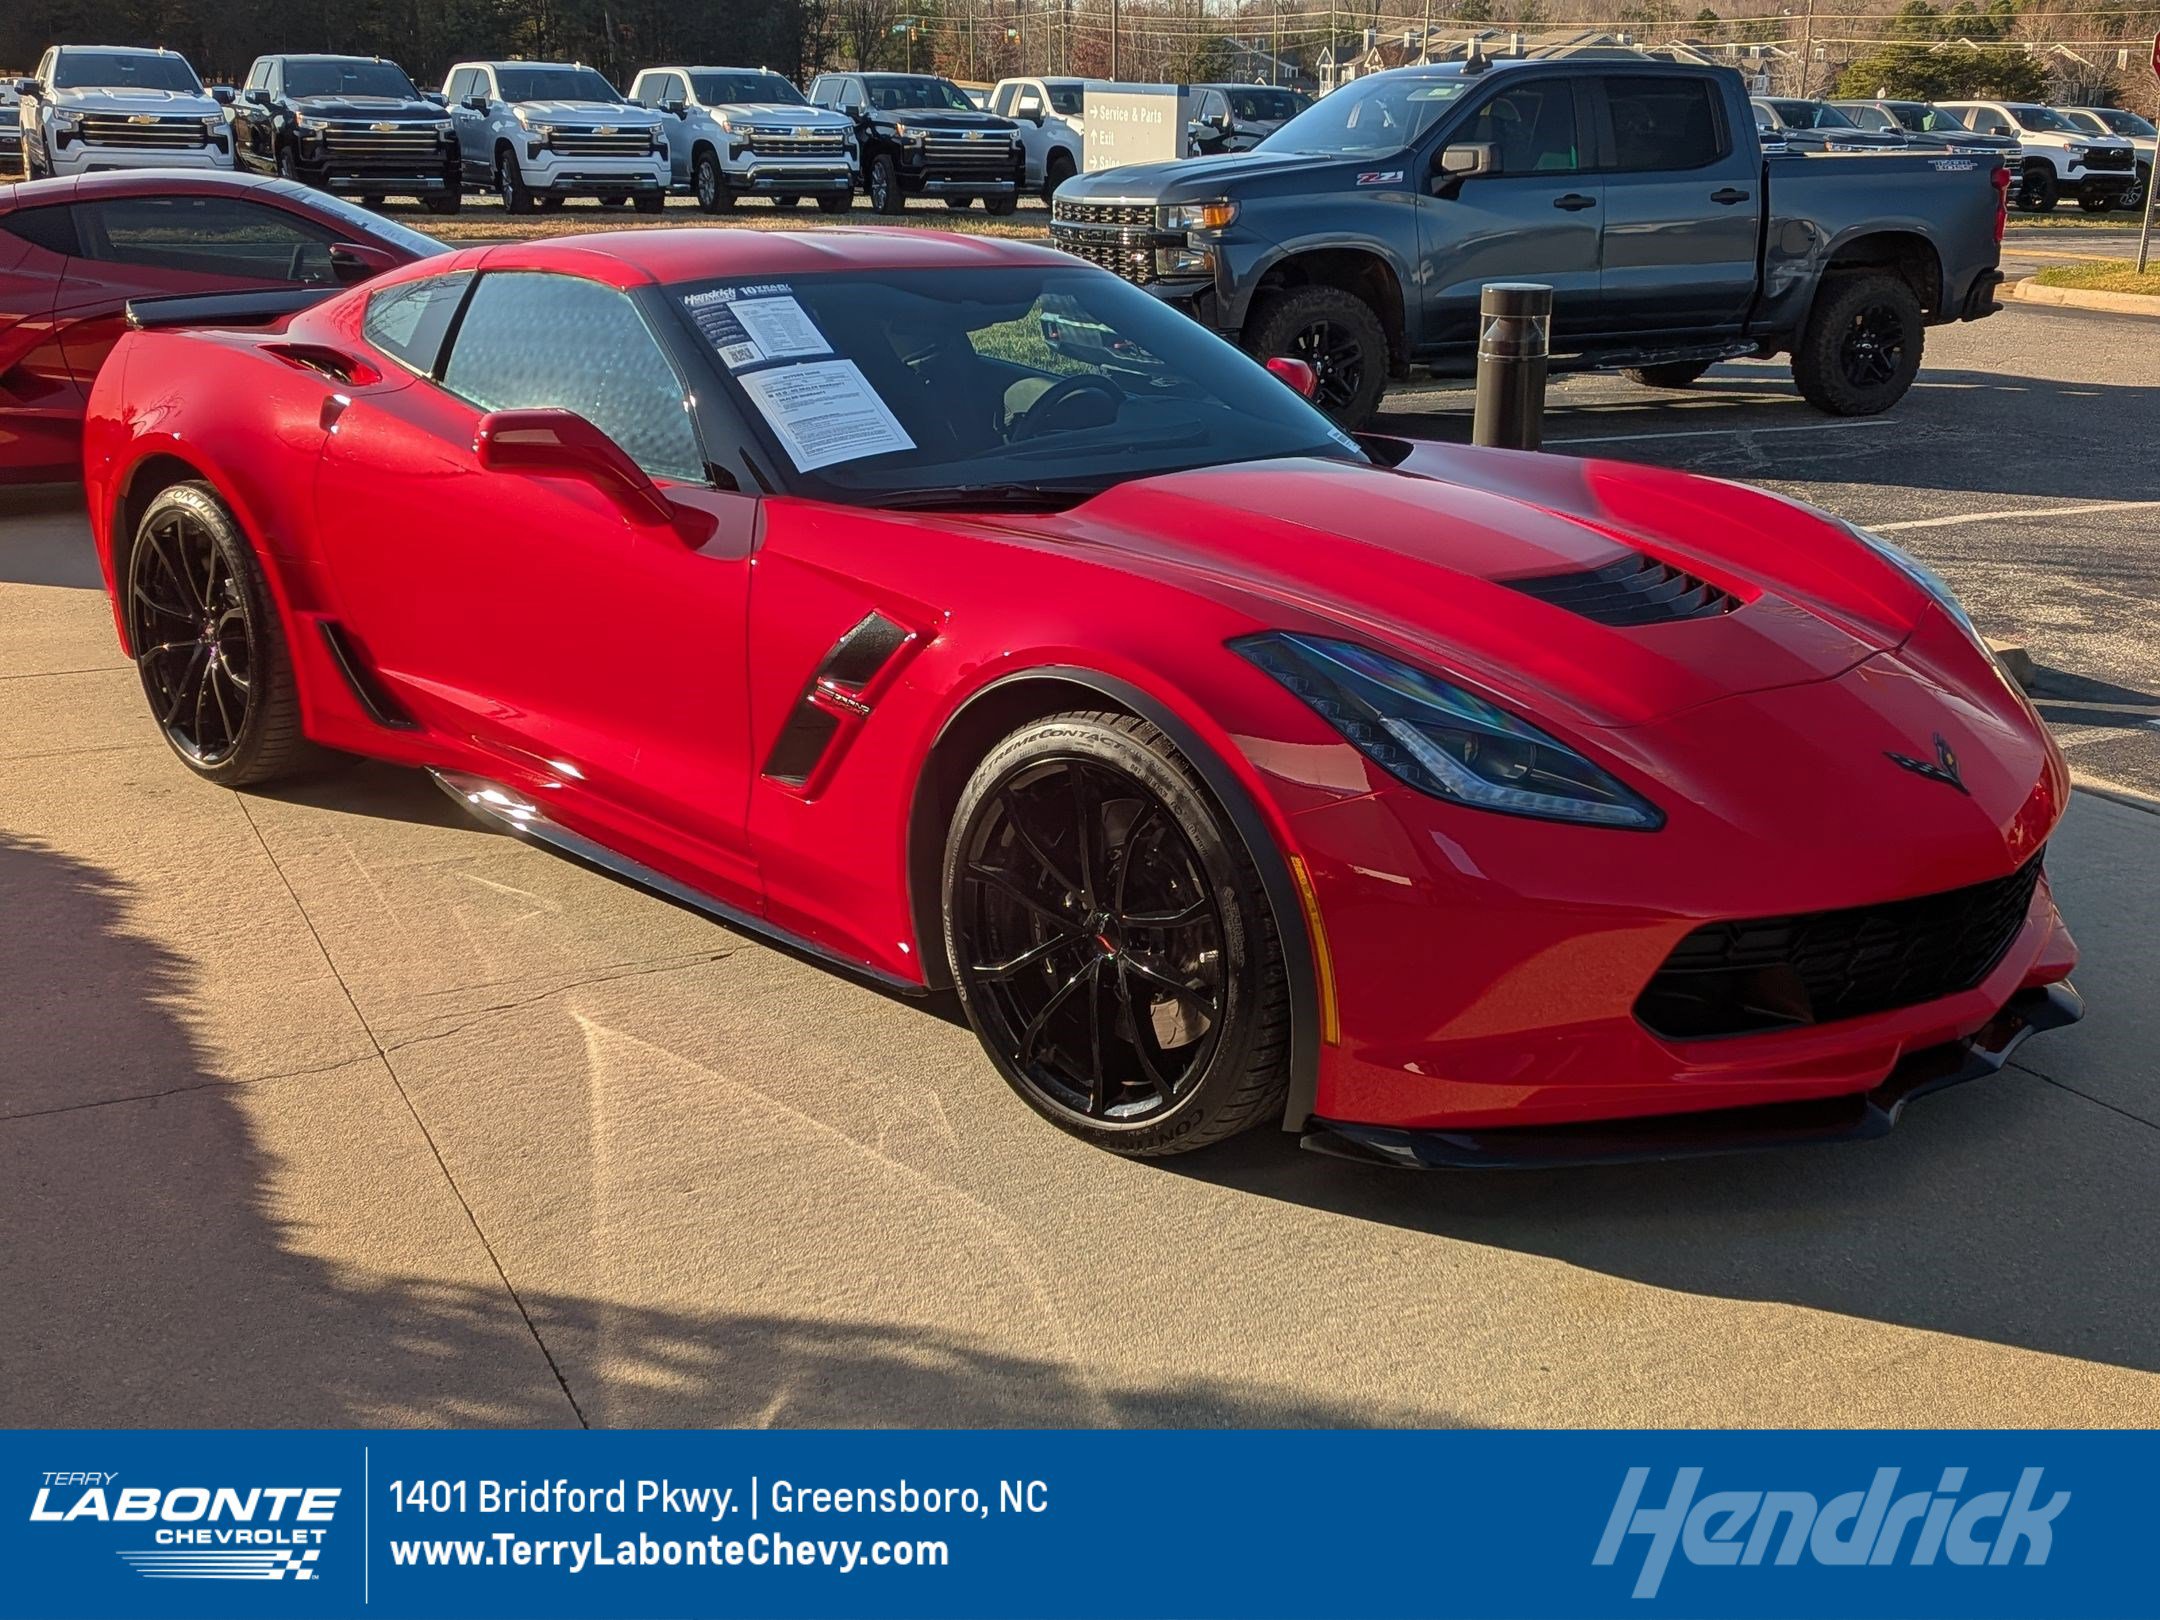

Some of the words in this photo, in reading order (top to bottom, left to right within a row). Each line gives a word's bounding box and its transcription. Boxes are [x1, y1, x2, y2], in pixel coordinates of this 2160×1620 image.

[1100, 105, 1129, 120] Service
[1131, 107, 1138, 121] &
[1141, 107, 1162, 123] Parts
[1100, 130, 1115, 146] Exit
[1356, 171, 1403, 186] Z71
